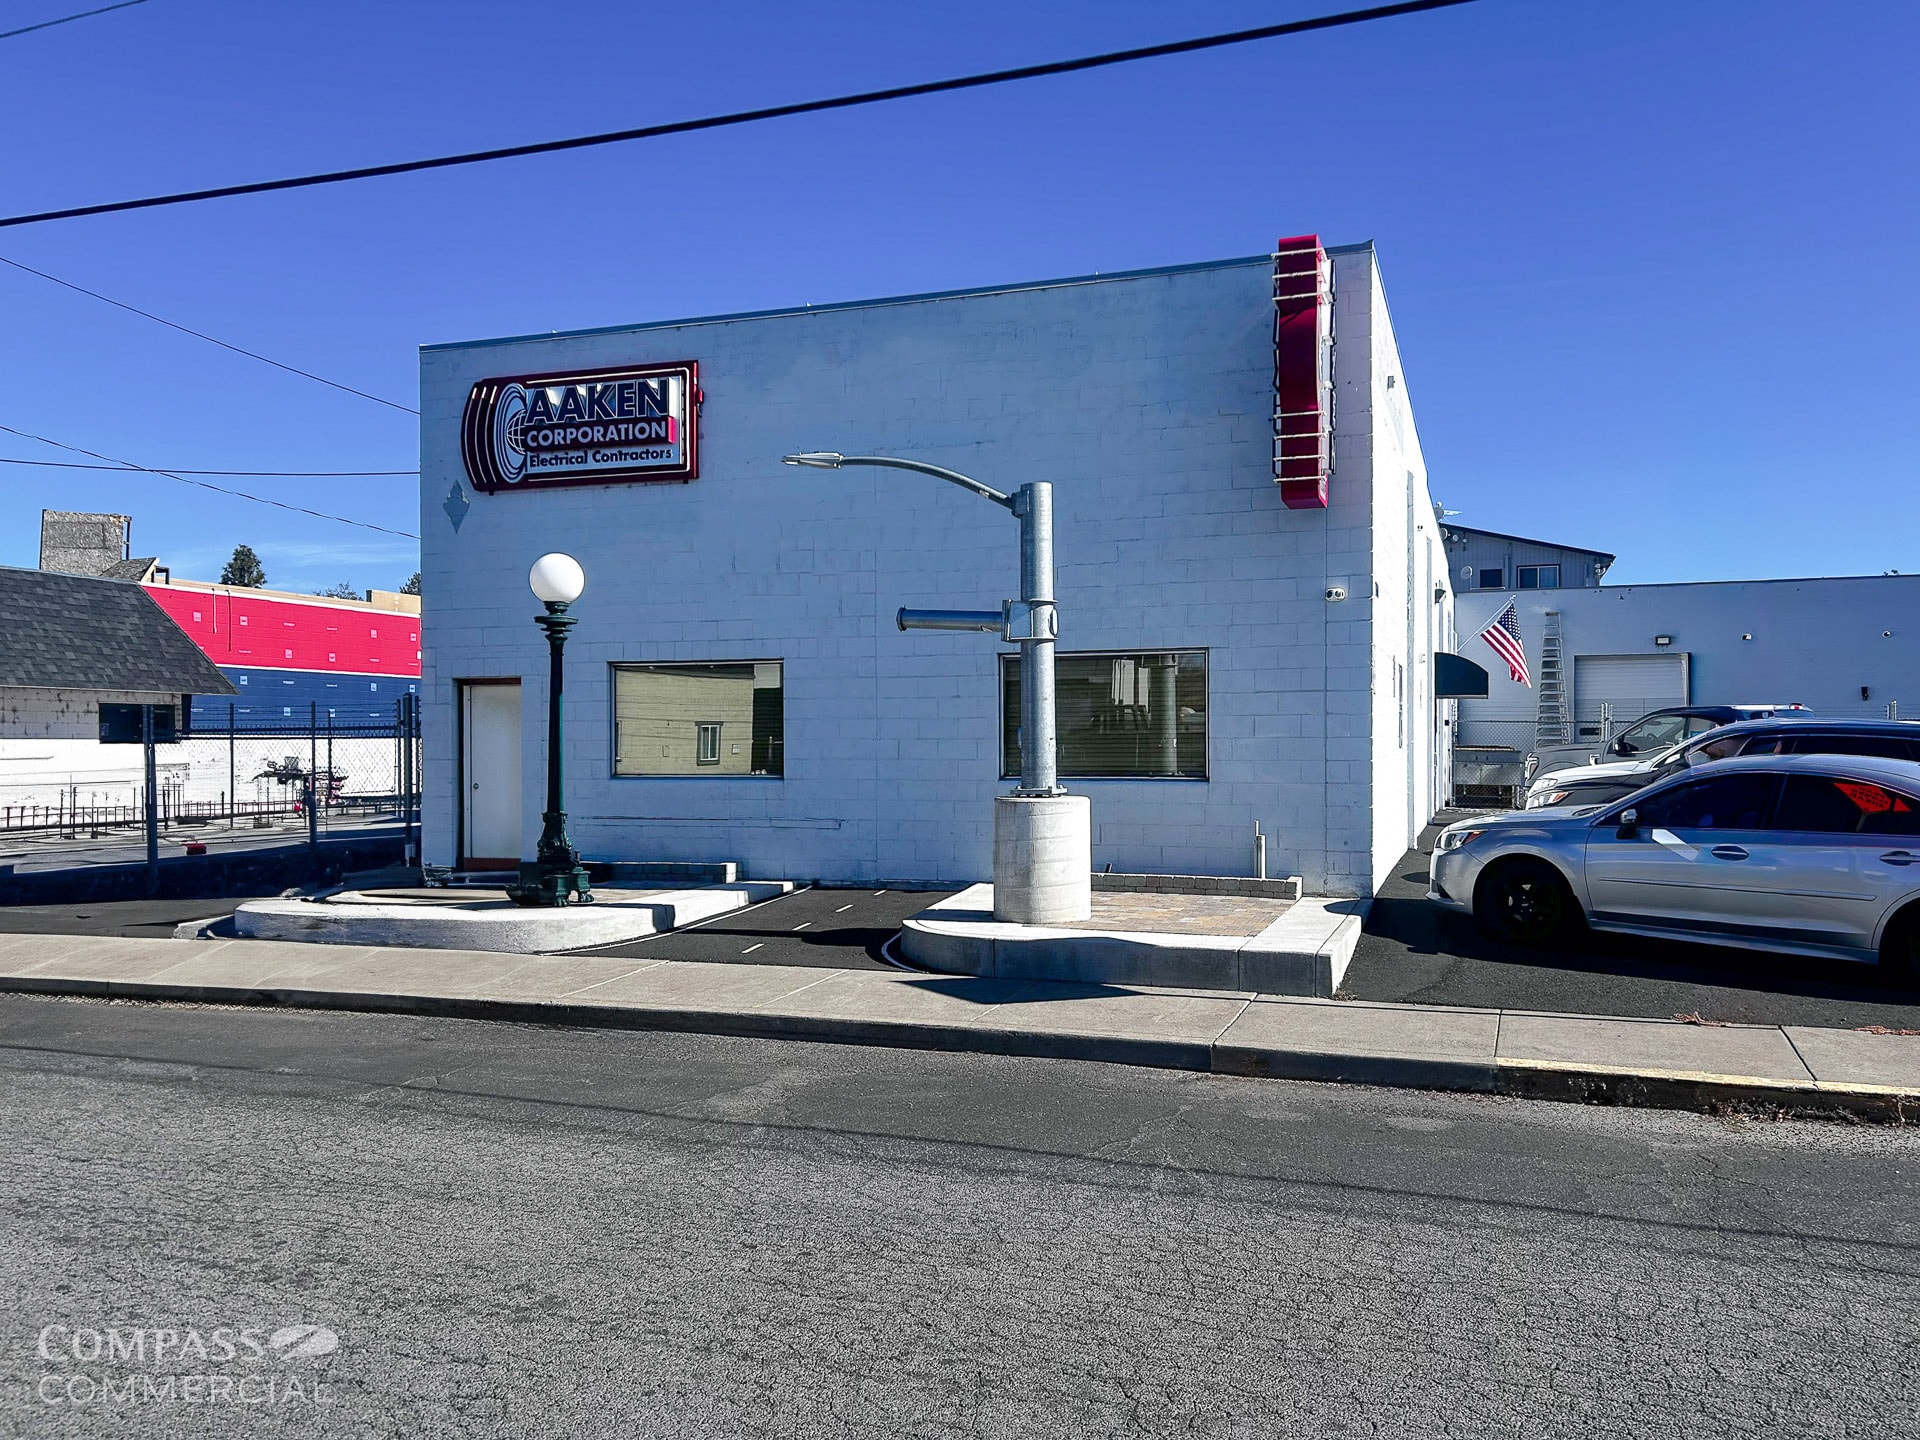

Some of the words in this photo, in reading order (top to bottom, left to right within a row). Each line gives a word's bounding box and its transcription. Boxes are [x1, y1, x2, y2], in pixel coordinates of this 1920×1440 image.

[524, 377, 670, 425] AAKEN
[526, 421, 666, 447] CORPORATION
[529, 451, 588, 468] Electrical
[592, 449, 672, 463] Contractors
